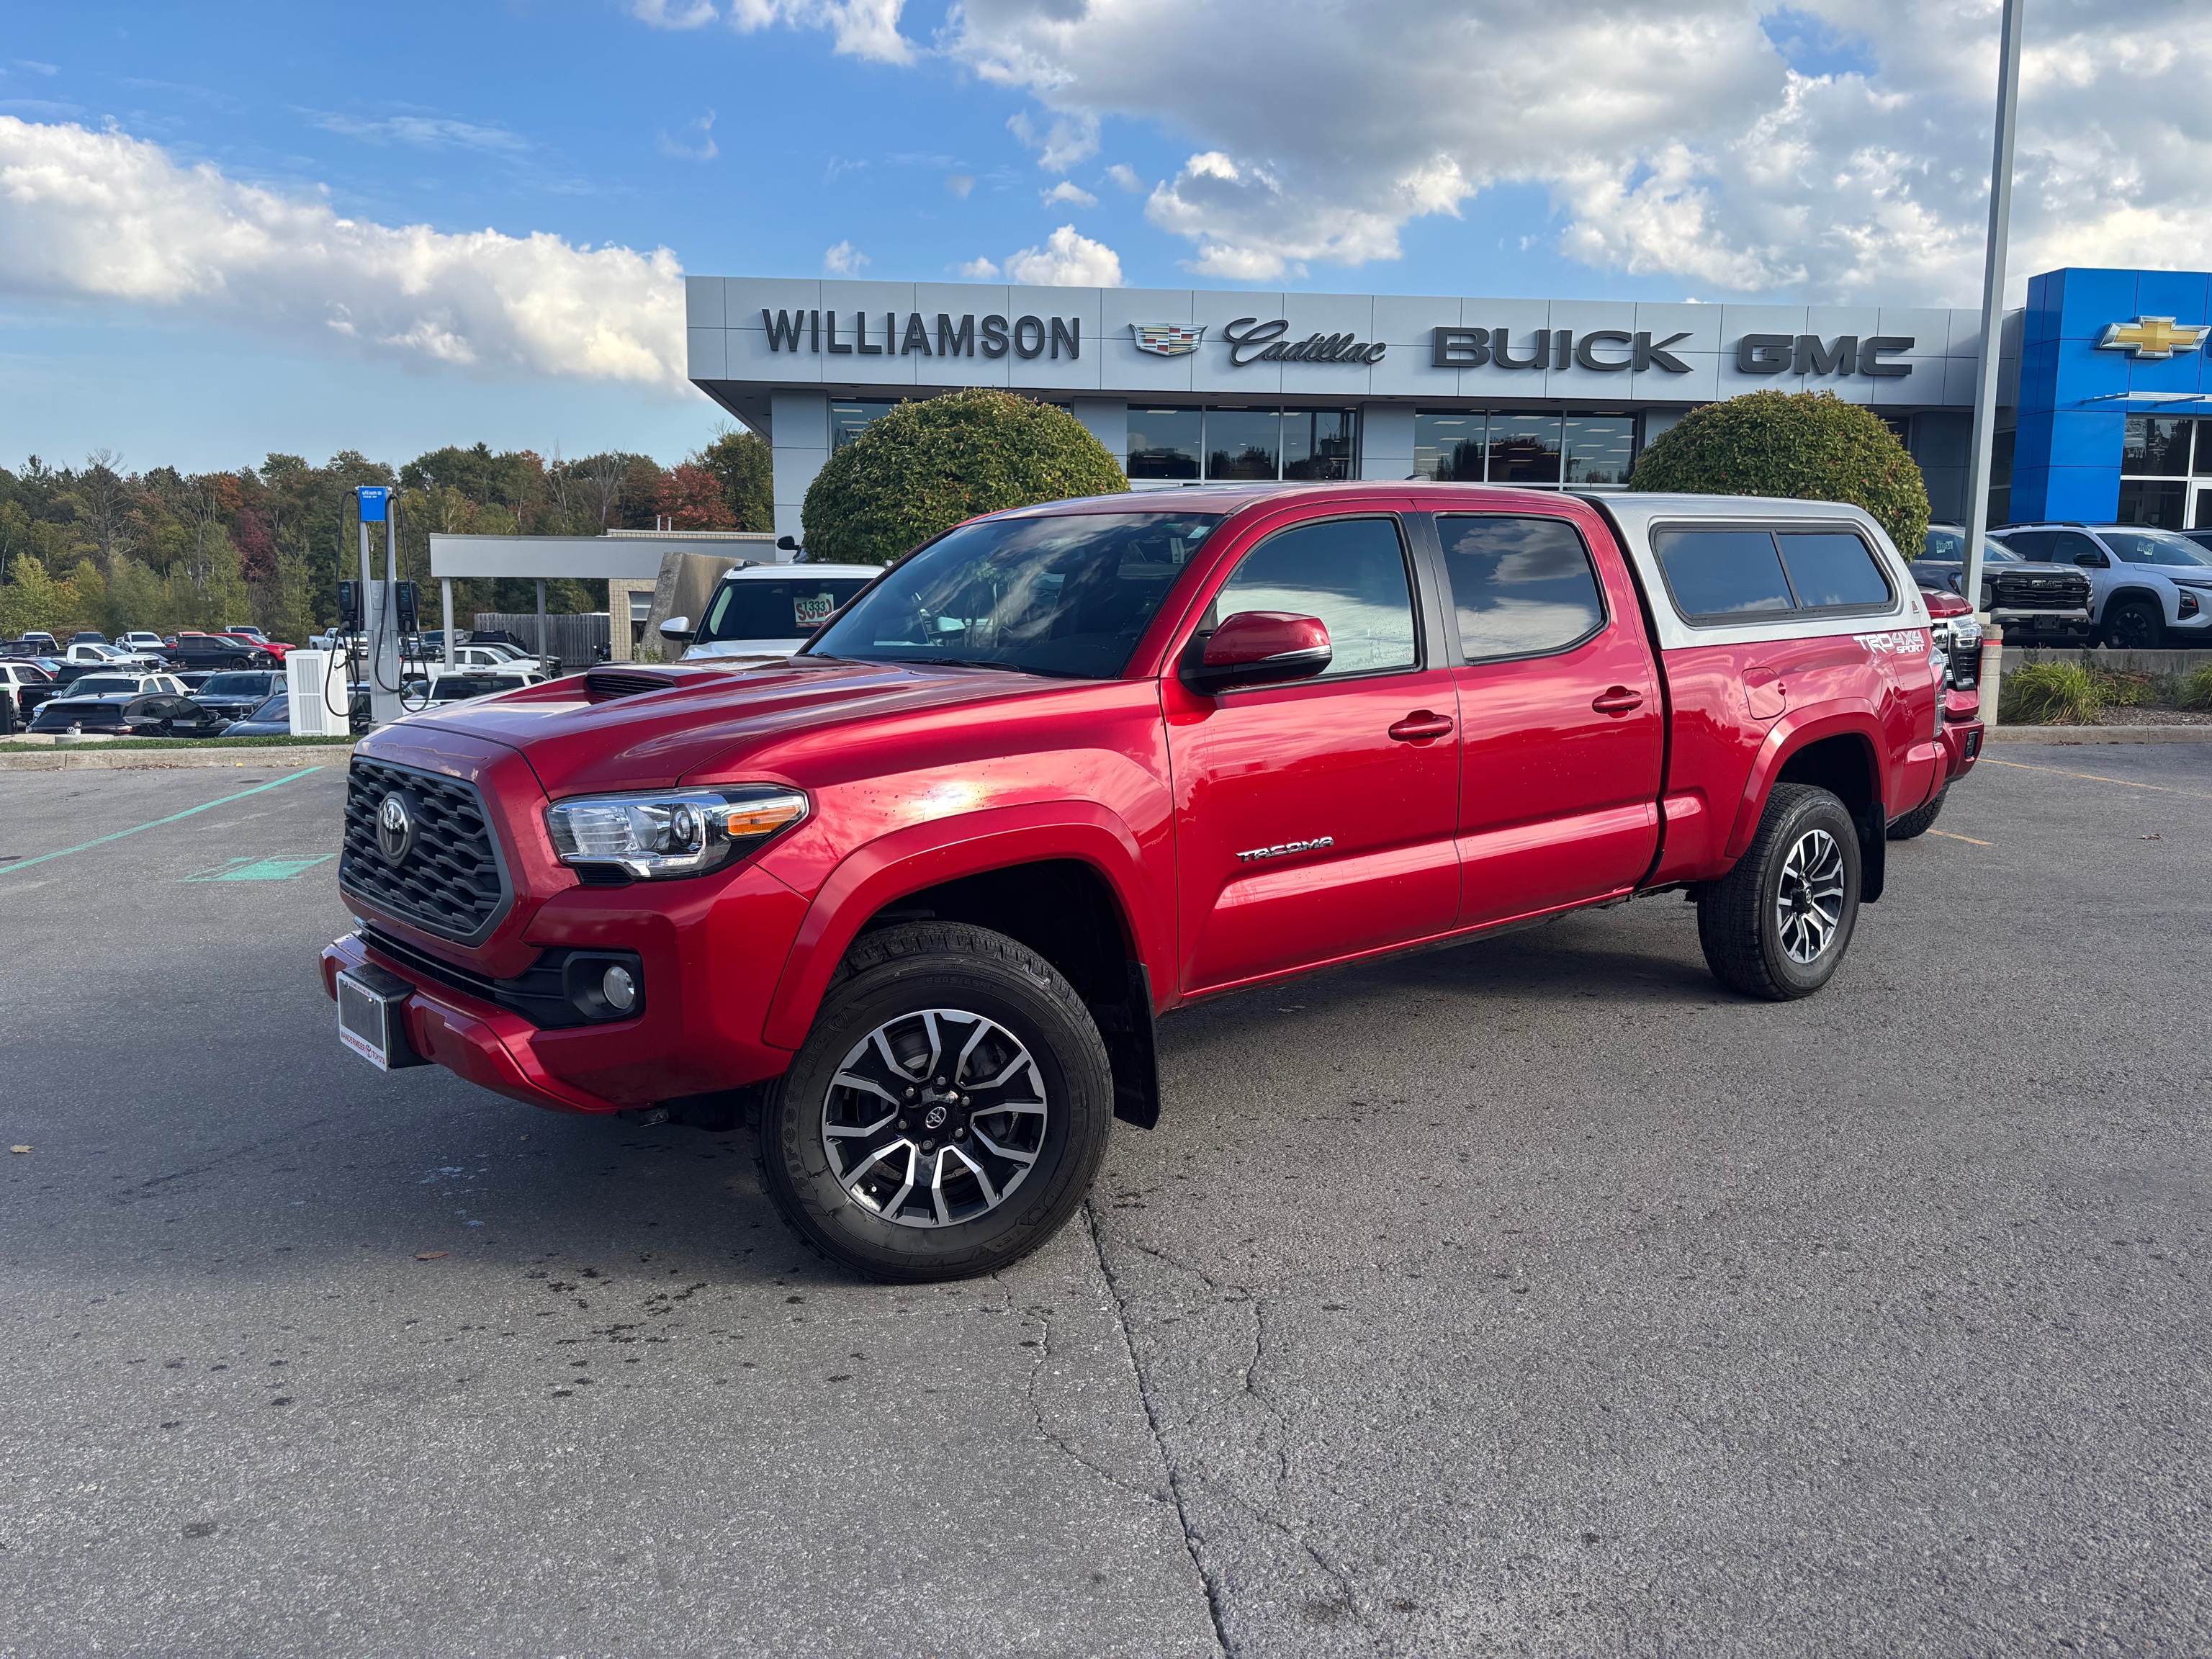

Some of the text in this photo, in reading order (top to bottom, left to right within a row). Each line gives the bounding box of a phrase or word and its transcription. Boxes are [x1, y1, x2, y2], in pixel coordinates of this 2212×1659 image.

[762, 308, 1080, 359] WILLIAMSON
[1224, 318, 1387, 367] Cadillac
[1432, 326, 1694, 372] BUICK
[1737, 333, 1915, 375] GMC
[802, 601, 826, 611] 1333
[1853, 633, 1894, 655] TRD
[1896, 644, 1925, 654] SPORT
[1235, 835, 1334, 863] TACOMA
[372, 1051, 386, 1066] TOYOTA
[1028, 1038, 1088, 1226] DESTINATION
